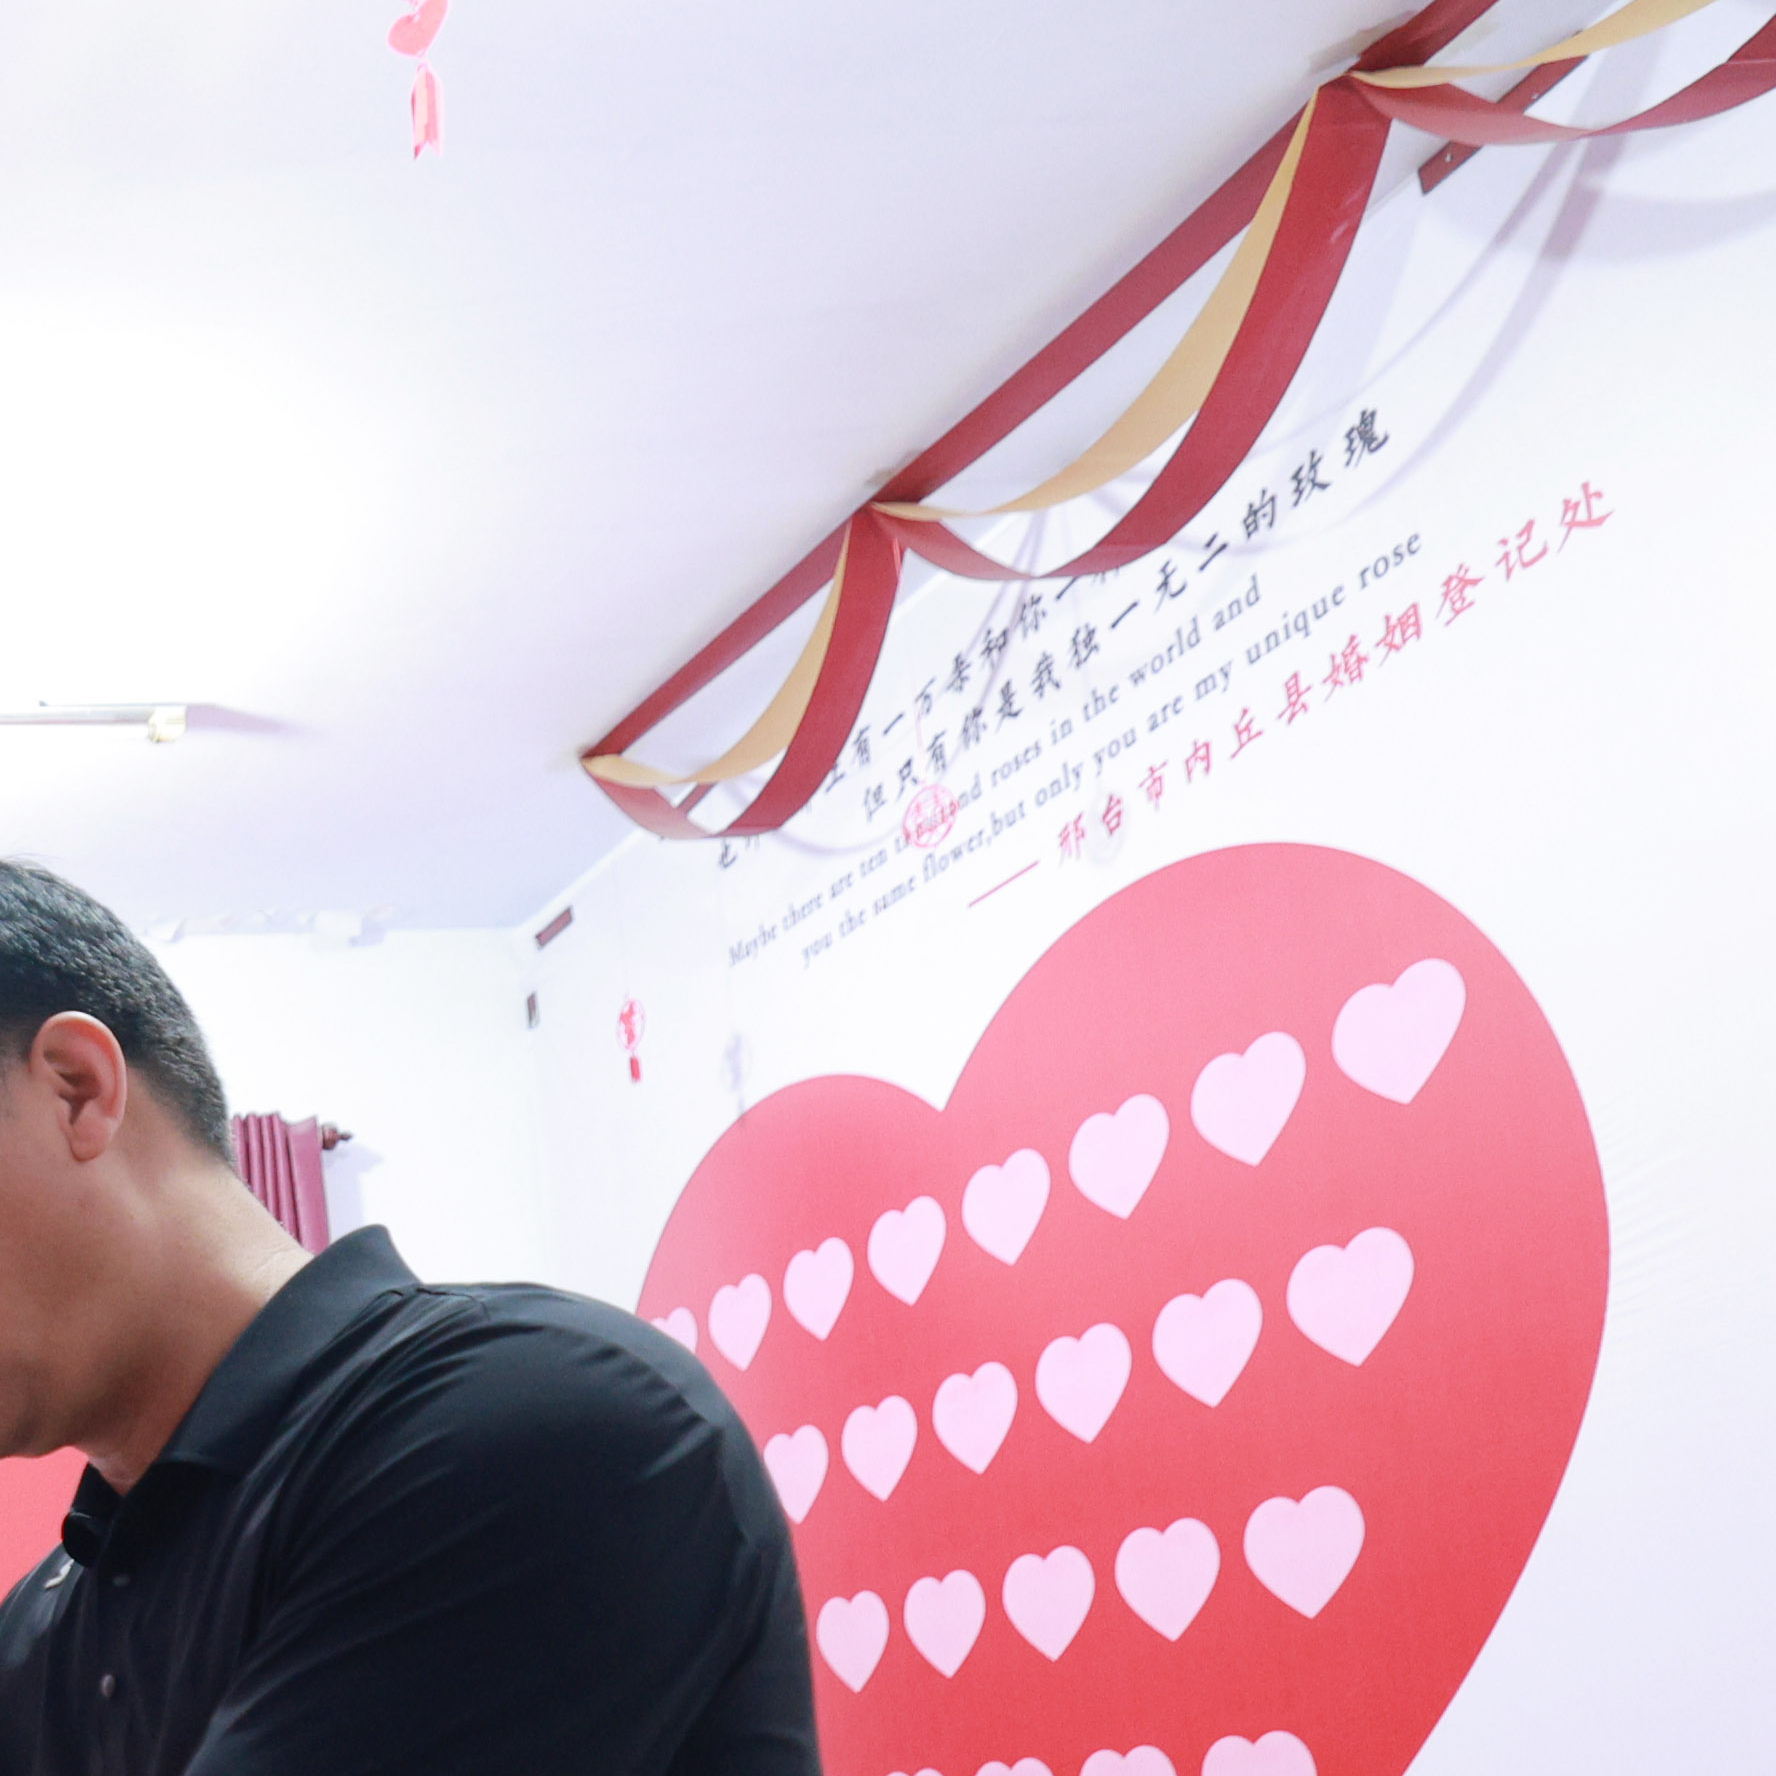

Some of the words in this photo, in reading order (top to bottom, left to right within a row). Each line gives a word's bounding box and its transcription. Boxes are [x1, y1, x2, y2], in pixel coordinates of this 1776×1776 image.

[729, 924, 778, 967] Maybe
[783, 892, 823, 931] there
[830, 872, 854, 899] are
[991, 740, 1042, 788] roses
[1050, 719, 1074, 745] in
[1083, 684, 1120, 723] the
[1129, 616, 1202, 687] world
[1213, 573, 1261, 631] and
[802, 932, 833, 968] you
[838, 908, 866, 938] the
[1034, 761, 1083, 807] only
[1093, 727, 1137, 777] you
[1148, 695, 1184, 733] are
[1195, 660, 1233, 701] my
[1246, 584, 1345, 665] unique
[1358, 533, 1422, 590] rose
[864, 408, 1389, 822] 但只有你是我独一无二的玫瑰
